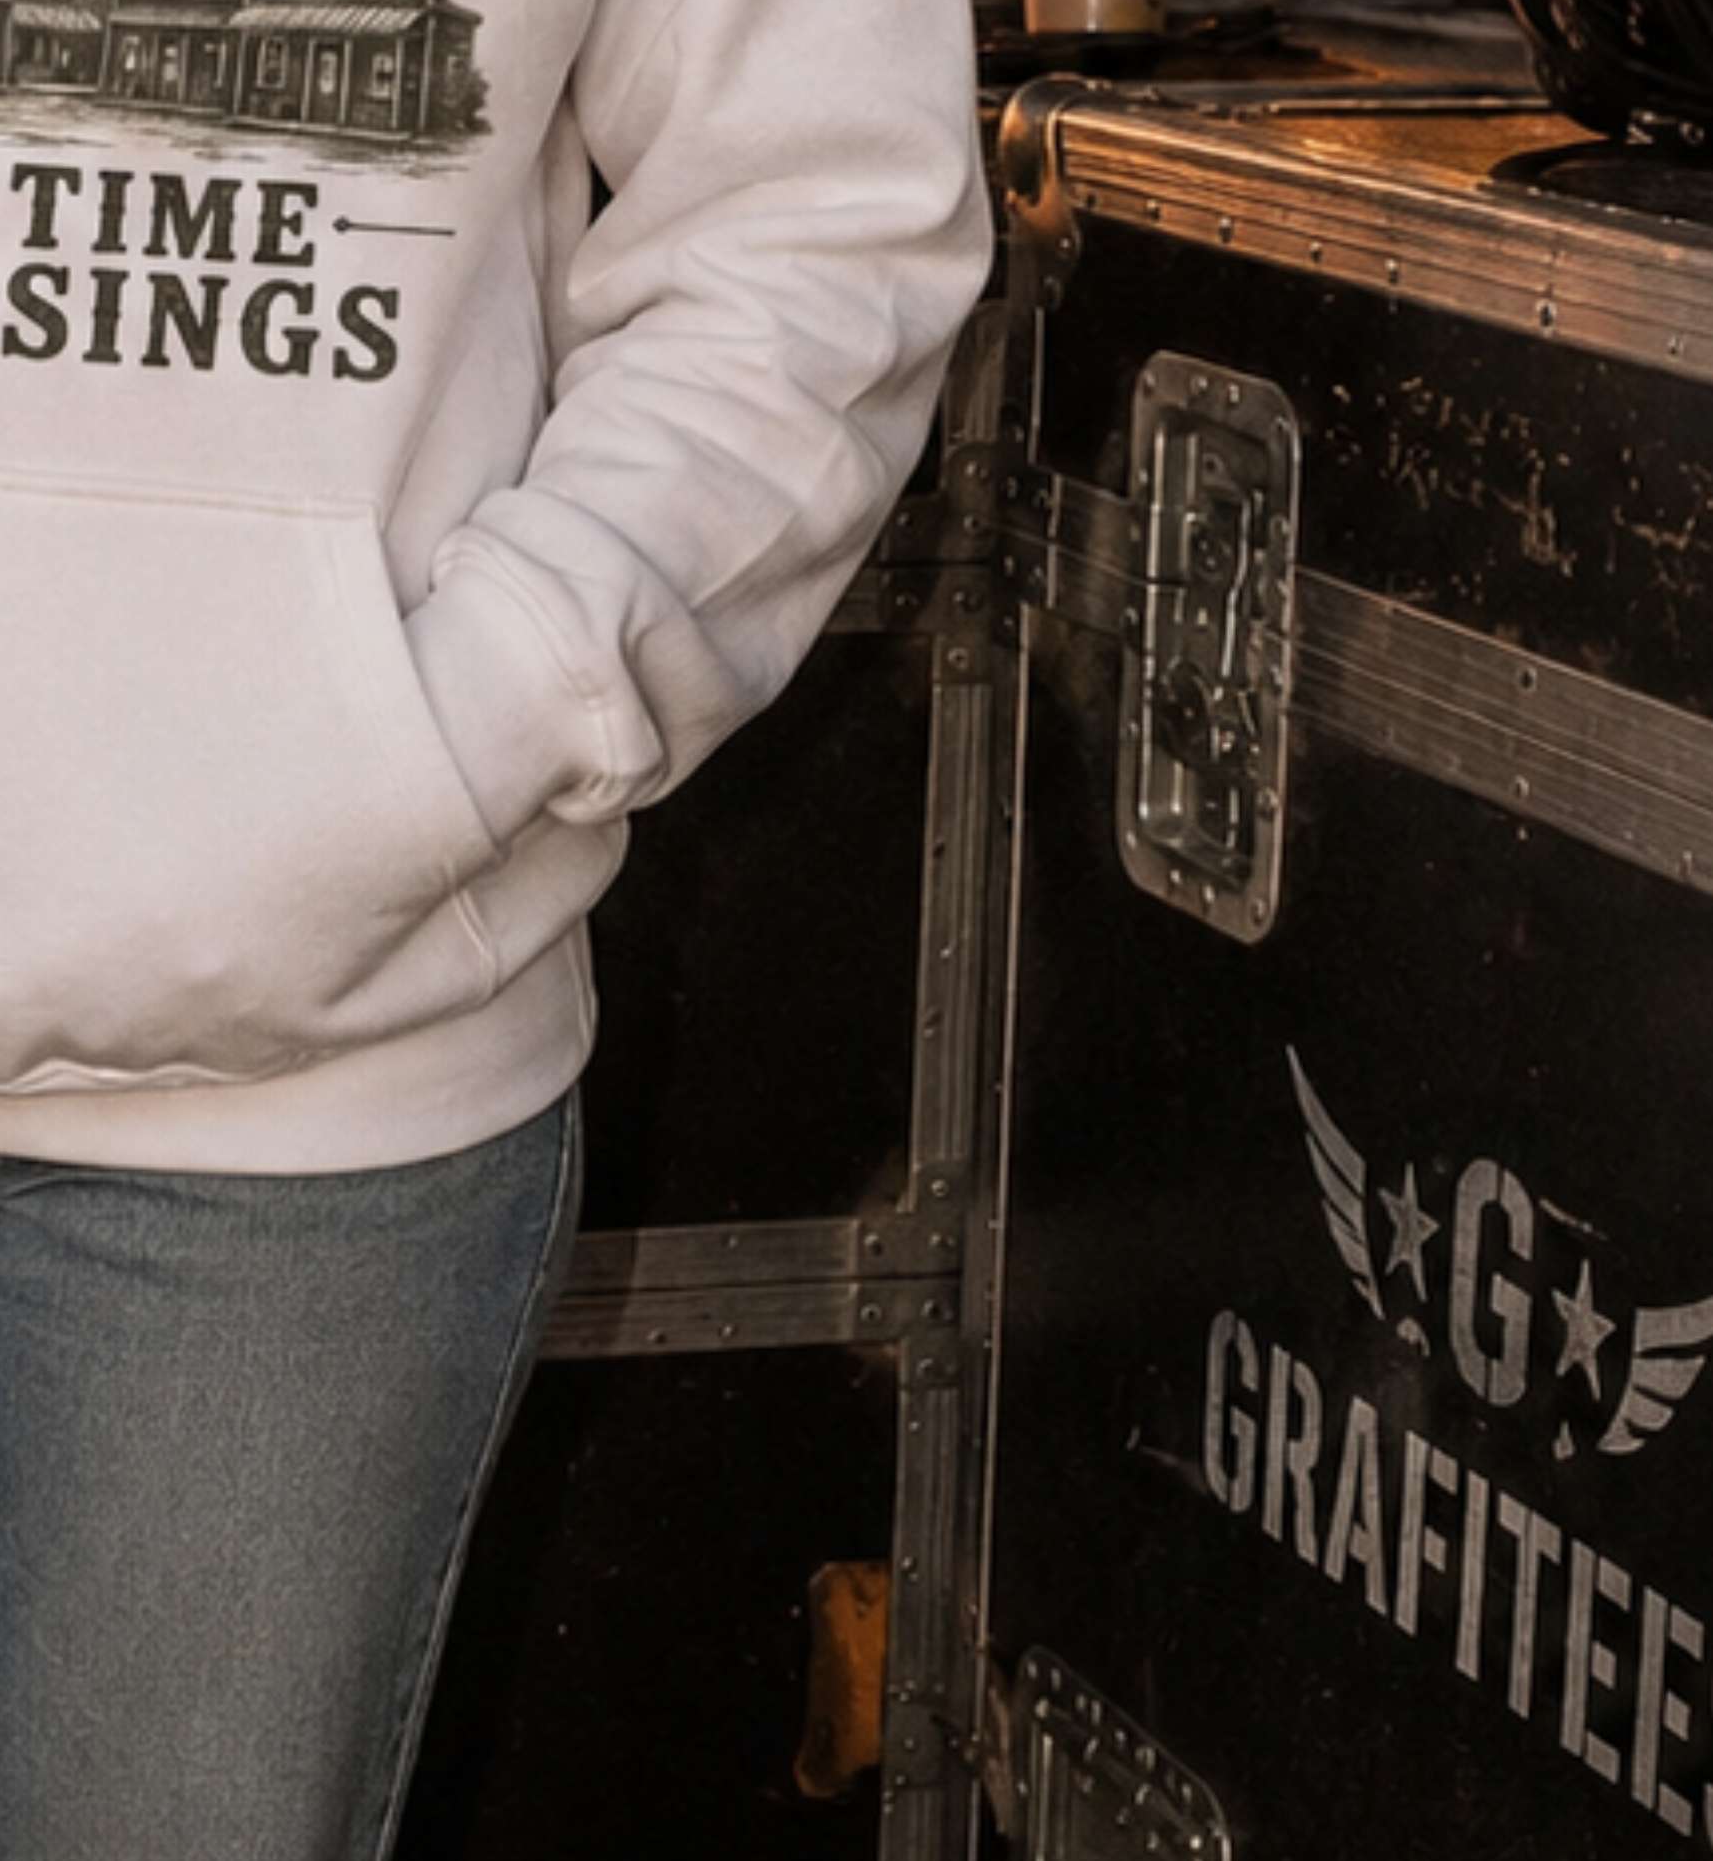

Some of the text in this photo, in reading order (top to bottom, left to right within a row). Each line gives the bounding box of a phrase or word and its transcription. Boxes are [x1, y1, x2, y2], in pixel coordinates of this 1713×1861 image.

[9, 161, 321, 269] TIME
[1449, 1158, 1535, 1407] G
[1203, 1310, 1713, 1845] GRAFITEE
